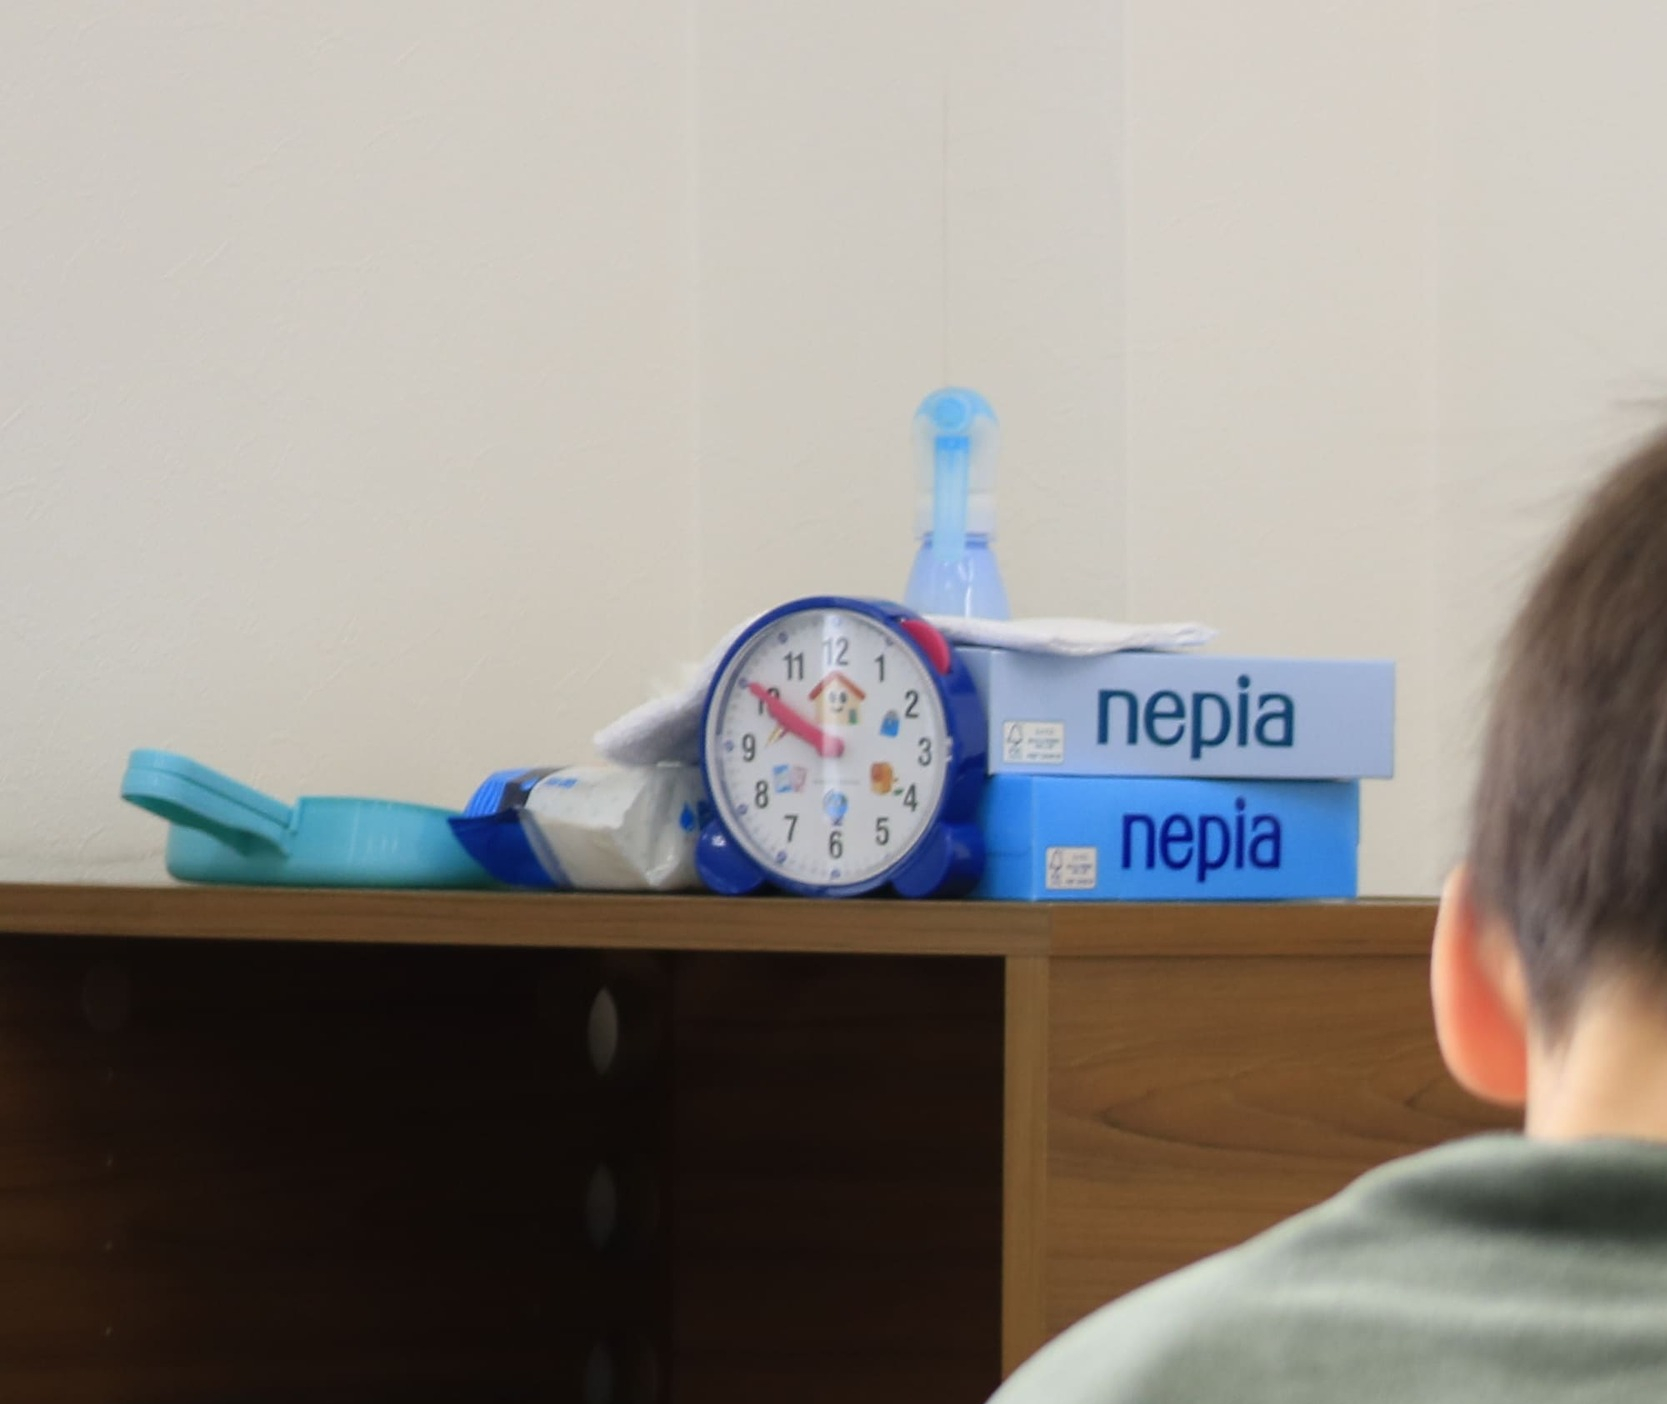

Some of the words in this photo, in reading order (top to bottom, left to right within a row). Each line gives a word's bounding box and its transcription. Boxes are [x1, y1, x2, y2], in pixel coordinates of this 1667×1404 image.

[783, 652, 804, 681] 11
[822, 638, 850, 667] 12
[874, 654, 886, 683] 1
[904, 690, 920, 718] 2
[1097, 673, 1295, 760] nepia
[741, 733, 757, 763] 9
[917, 737, 933, 767] 3
[755, 780, 770, 810] 8
[902, 783, 919, 812] 4
[783, 814, 798, 843] 7
[875, 816, 890, 846] 5
[1121, 796, 1283, 883] nepia
[828, 829, 844, 860] 6
